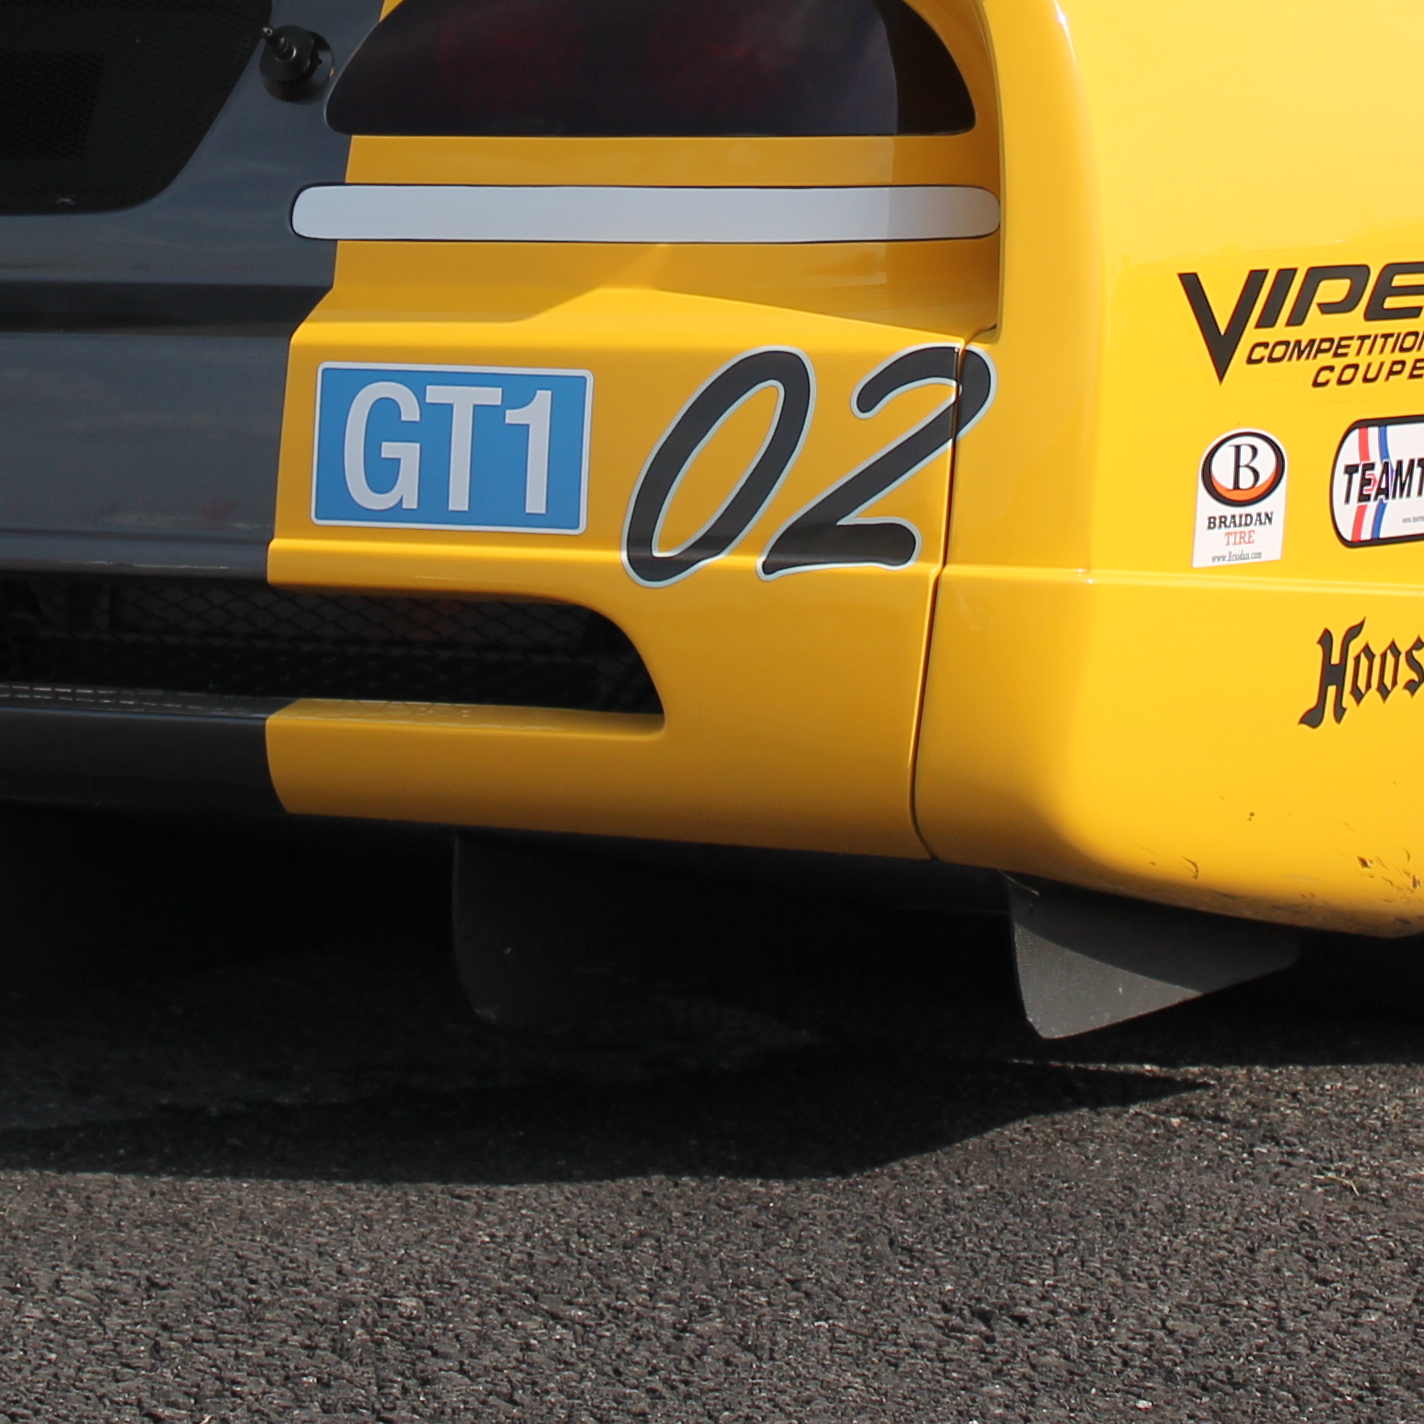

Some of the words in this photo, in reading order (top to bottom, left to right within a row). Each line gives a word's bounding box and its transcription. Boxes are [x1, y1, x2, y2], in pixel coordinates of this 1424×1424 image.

[342, 380, 553, 515] GT1
[621, 345, 997, 588] 02
[1207, 510, 1275, 531] BRAIDAN
[1224, 529, 1256, 547] TIRE
